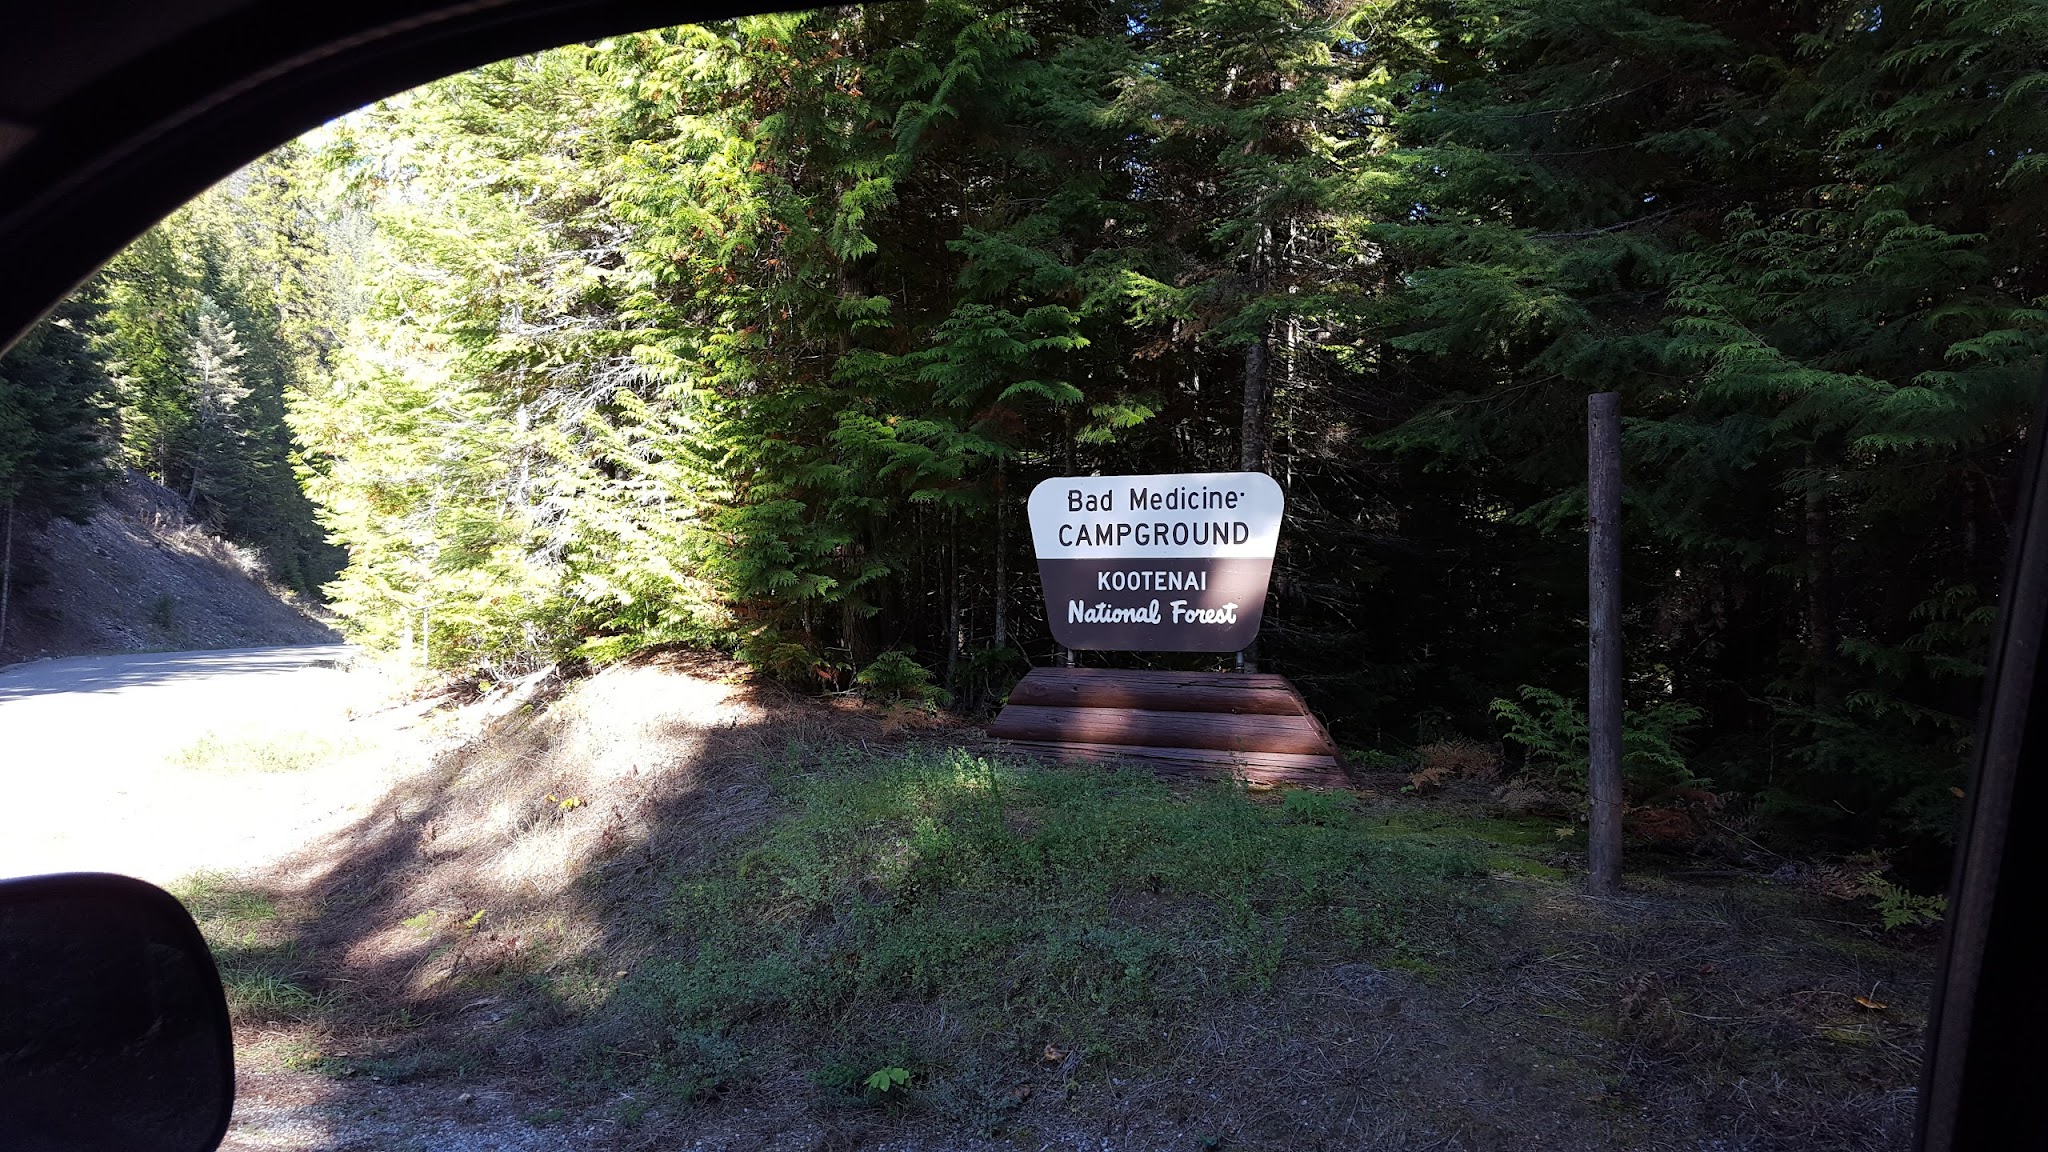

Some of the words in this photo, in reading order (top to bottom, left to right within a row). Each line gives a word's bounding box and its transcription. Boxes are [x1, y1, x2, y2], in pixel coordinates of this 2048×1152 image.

[1068, 489, 1113, 512] Bad
[1130, 486, 1238, 511] Medicine
[1058, 521, 1249, 547] CAMPGROUND
[1097, 571, 1207, 591] KOOTENAI
[1068, 599, 1161, 625] National
[1170, 600, 1238, 625] Forest
